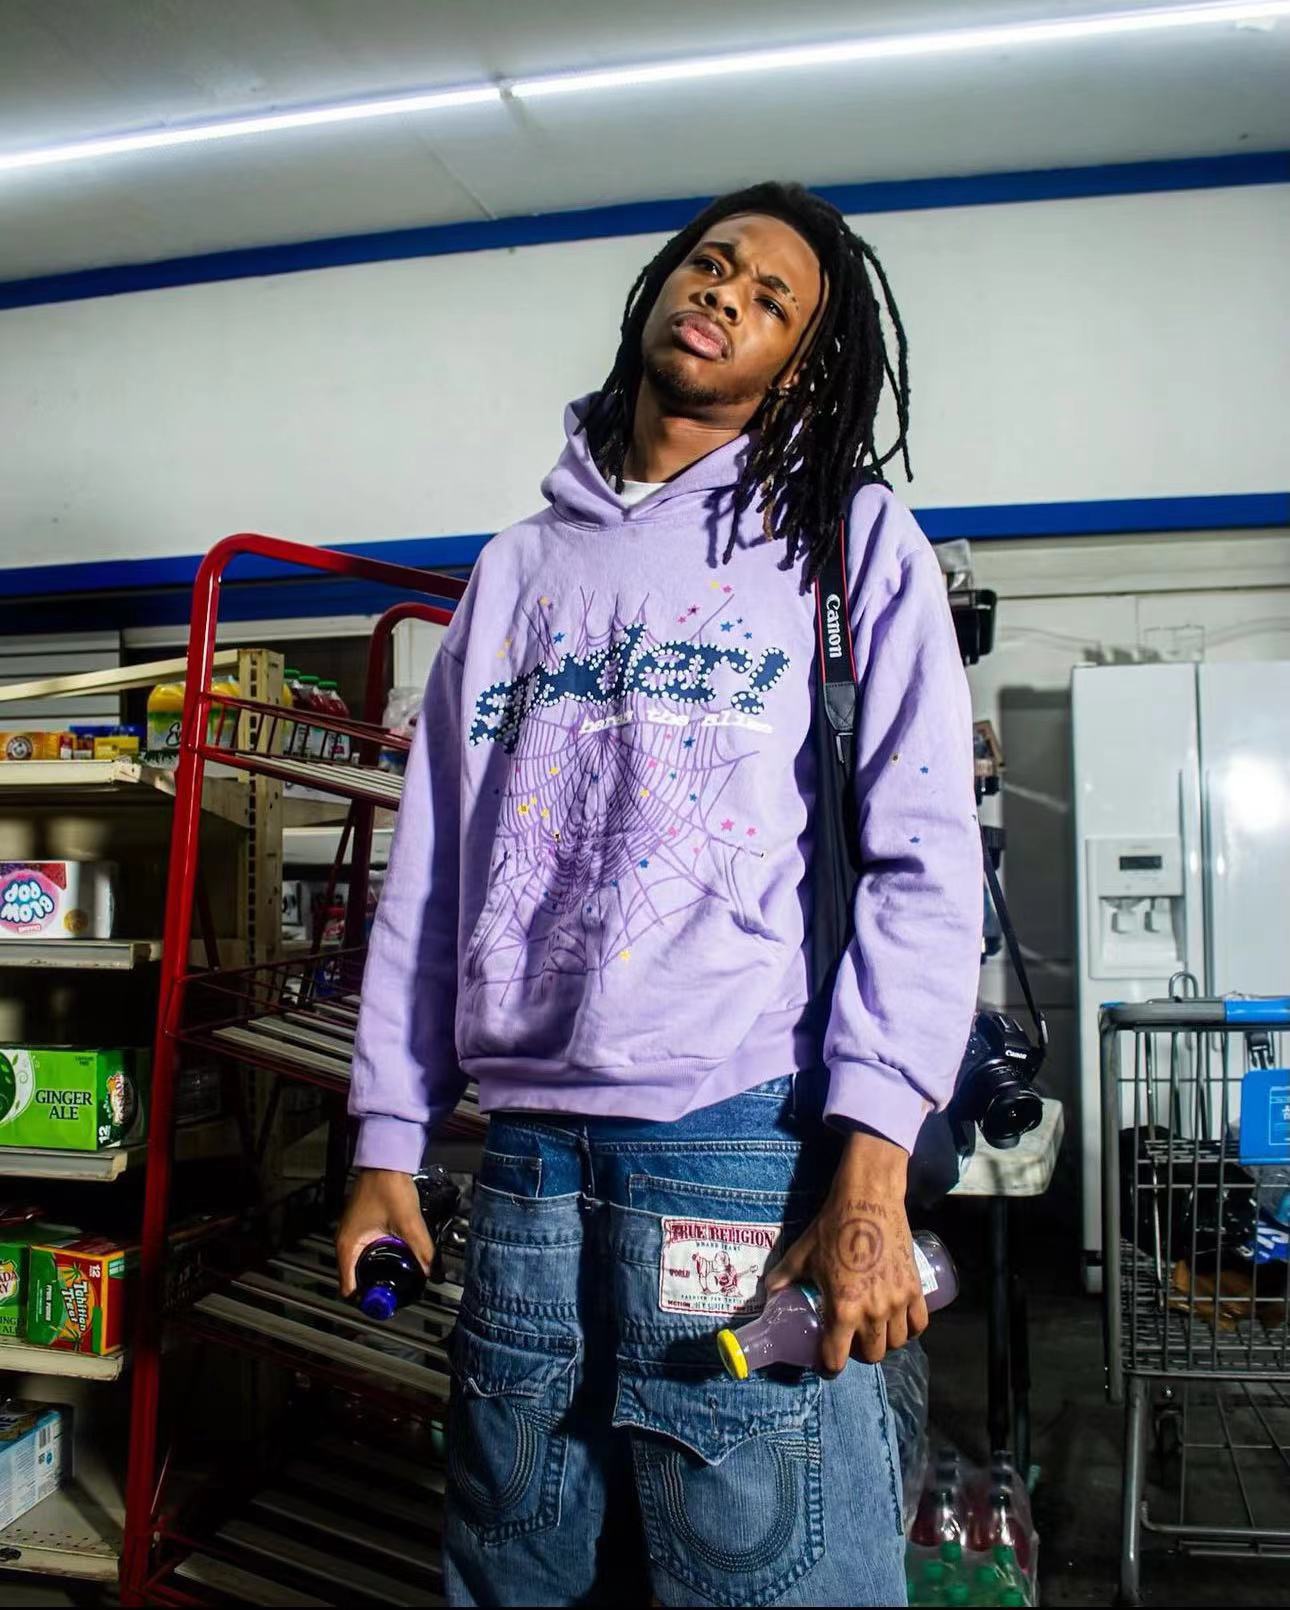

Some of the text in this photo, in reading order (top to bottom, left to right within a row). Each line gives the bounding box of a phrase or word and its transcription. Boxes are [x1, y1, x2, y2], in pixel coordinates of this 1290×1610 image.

[826, 593, 842, 658] Canon
[4, 880, 42, 903] POP
[35, 1089, 93, 1105] GINGER
[49, 1105, 79, 1120] ALE
[98, 1125, 109, 1143] 12
[671, 1224, 774, 1249] TRUE RELIGION
[92, 1264, 101, 1278] 12
[669, 1268, 690, 1278] WORLD
[61, 1288, 78, 1323] Treat
[73, 1280, 88, 1331] Tahitian
